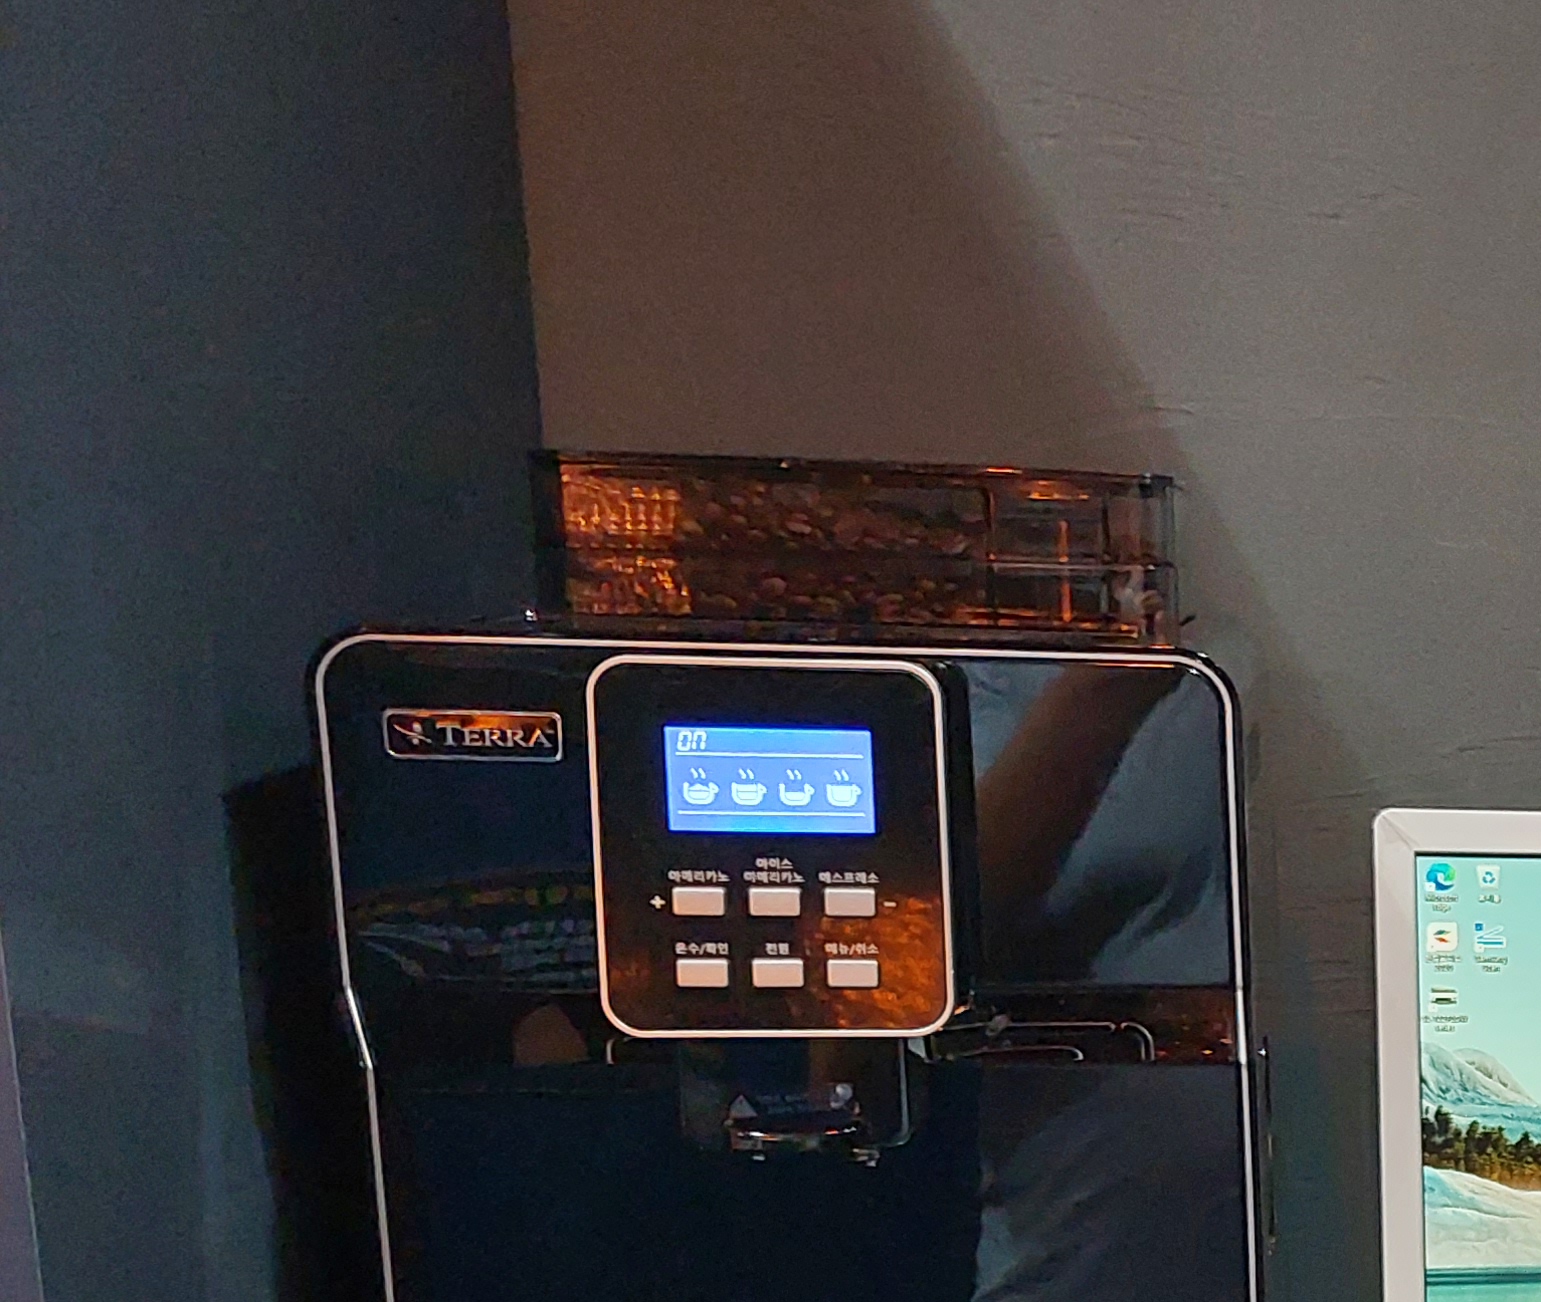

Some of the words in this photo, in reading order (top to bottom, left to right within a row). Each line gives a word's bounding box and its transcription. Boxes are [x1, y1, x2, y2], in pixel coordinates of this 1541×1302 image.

[436, 724, 553, 749] TERRA
[754, 857, 794, 870] 아이스
[667, 870, 731, 883] 아메리카노
[742, 871, 806, 884] 아메리카노
[817, 871, 880, 884] 에스프레소
